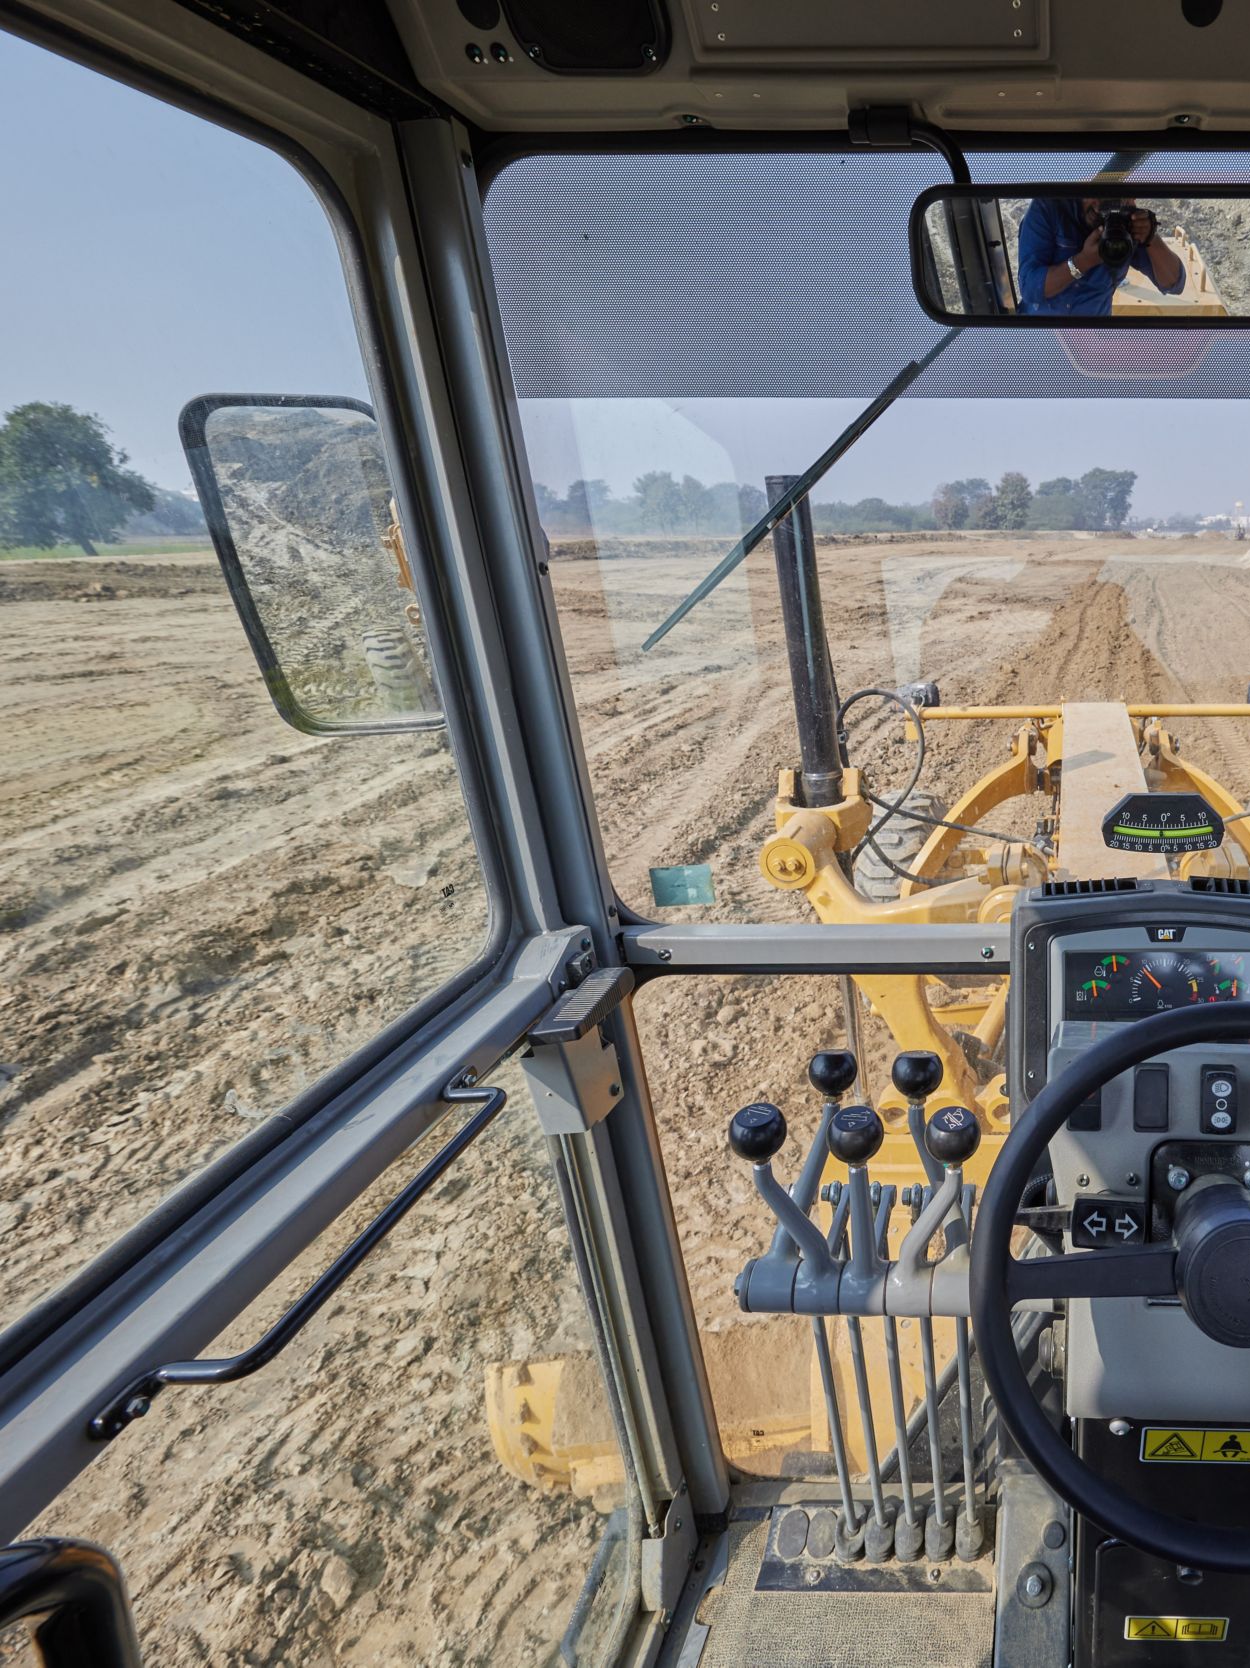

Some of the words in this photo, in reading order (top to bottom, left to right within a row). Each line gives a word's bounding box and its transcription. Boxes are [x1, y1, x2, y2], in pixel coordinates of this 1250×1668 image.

[1122, 812, 1130, 820] 10
[1160, 812, 1171, 822] 0°
[1197, 812, 1207, 820] 10
[1109, 840, 1119, 848] 20
[1122, 842, 1131, 850] 15
[1196, 842, 1205, 850] 15
[1208, 840, 1217, 848] 20
[1158, 929, 1176, 940] CAT
